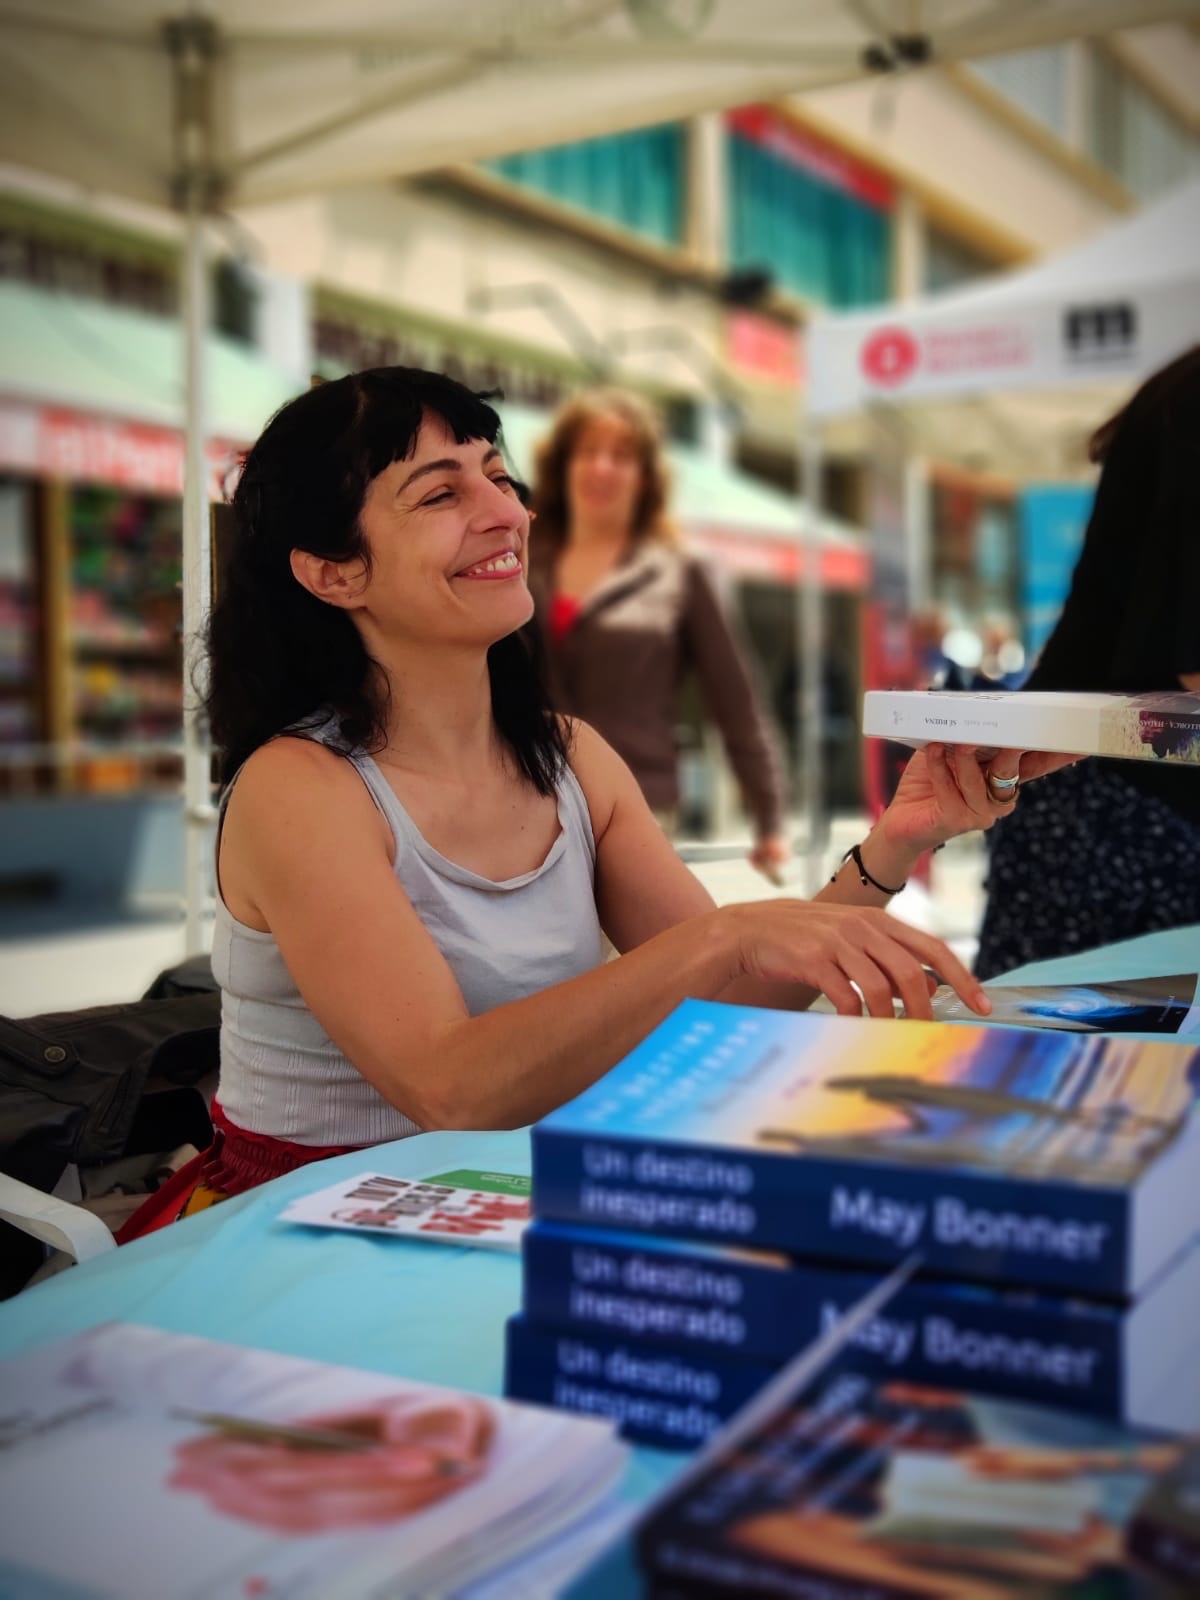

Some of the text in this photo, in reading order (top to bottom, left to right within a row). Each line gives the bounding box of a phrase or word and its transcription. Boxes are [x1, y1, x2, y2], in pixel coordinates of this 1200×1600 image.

[583, 1143, 755, 1194] Un destino
[580, 1177, 758, 1234] inesperado
[829, 1186, 1110, 1261] May Bonner
[572, 1249, 744, 1304] Un destino
[569, 1283, 747, 1345] inesperado
[556, 1337, 721, 1402] Un destino
[922, 1313, 1098, 1386] Bonner
[553, 1374, 724, 1441] inesperado
